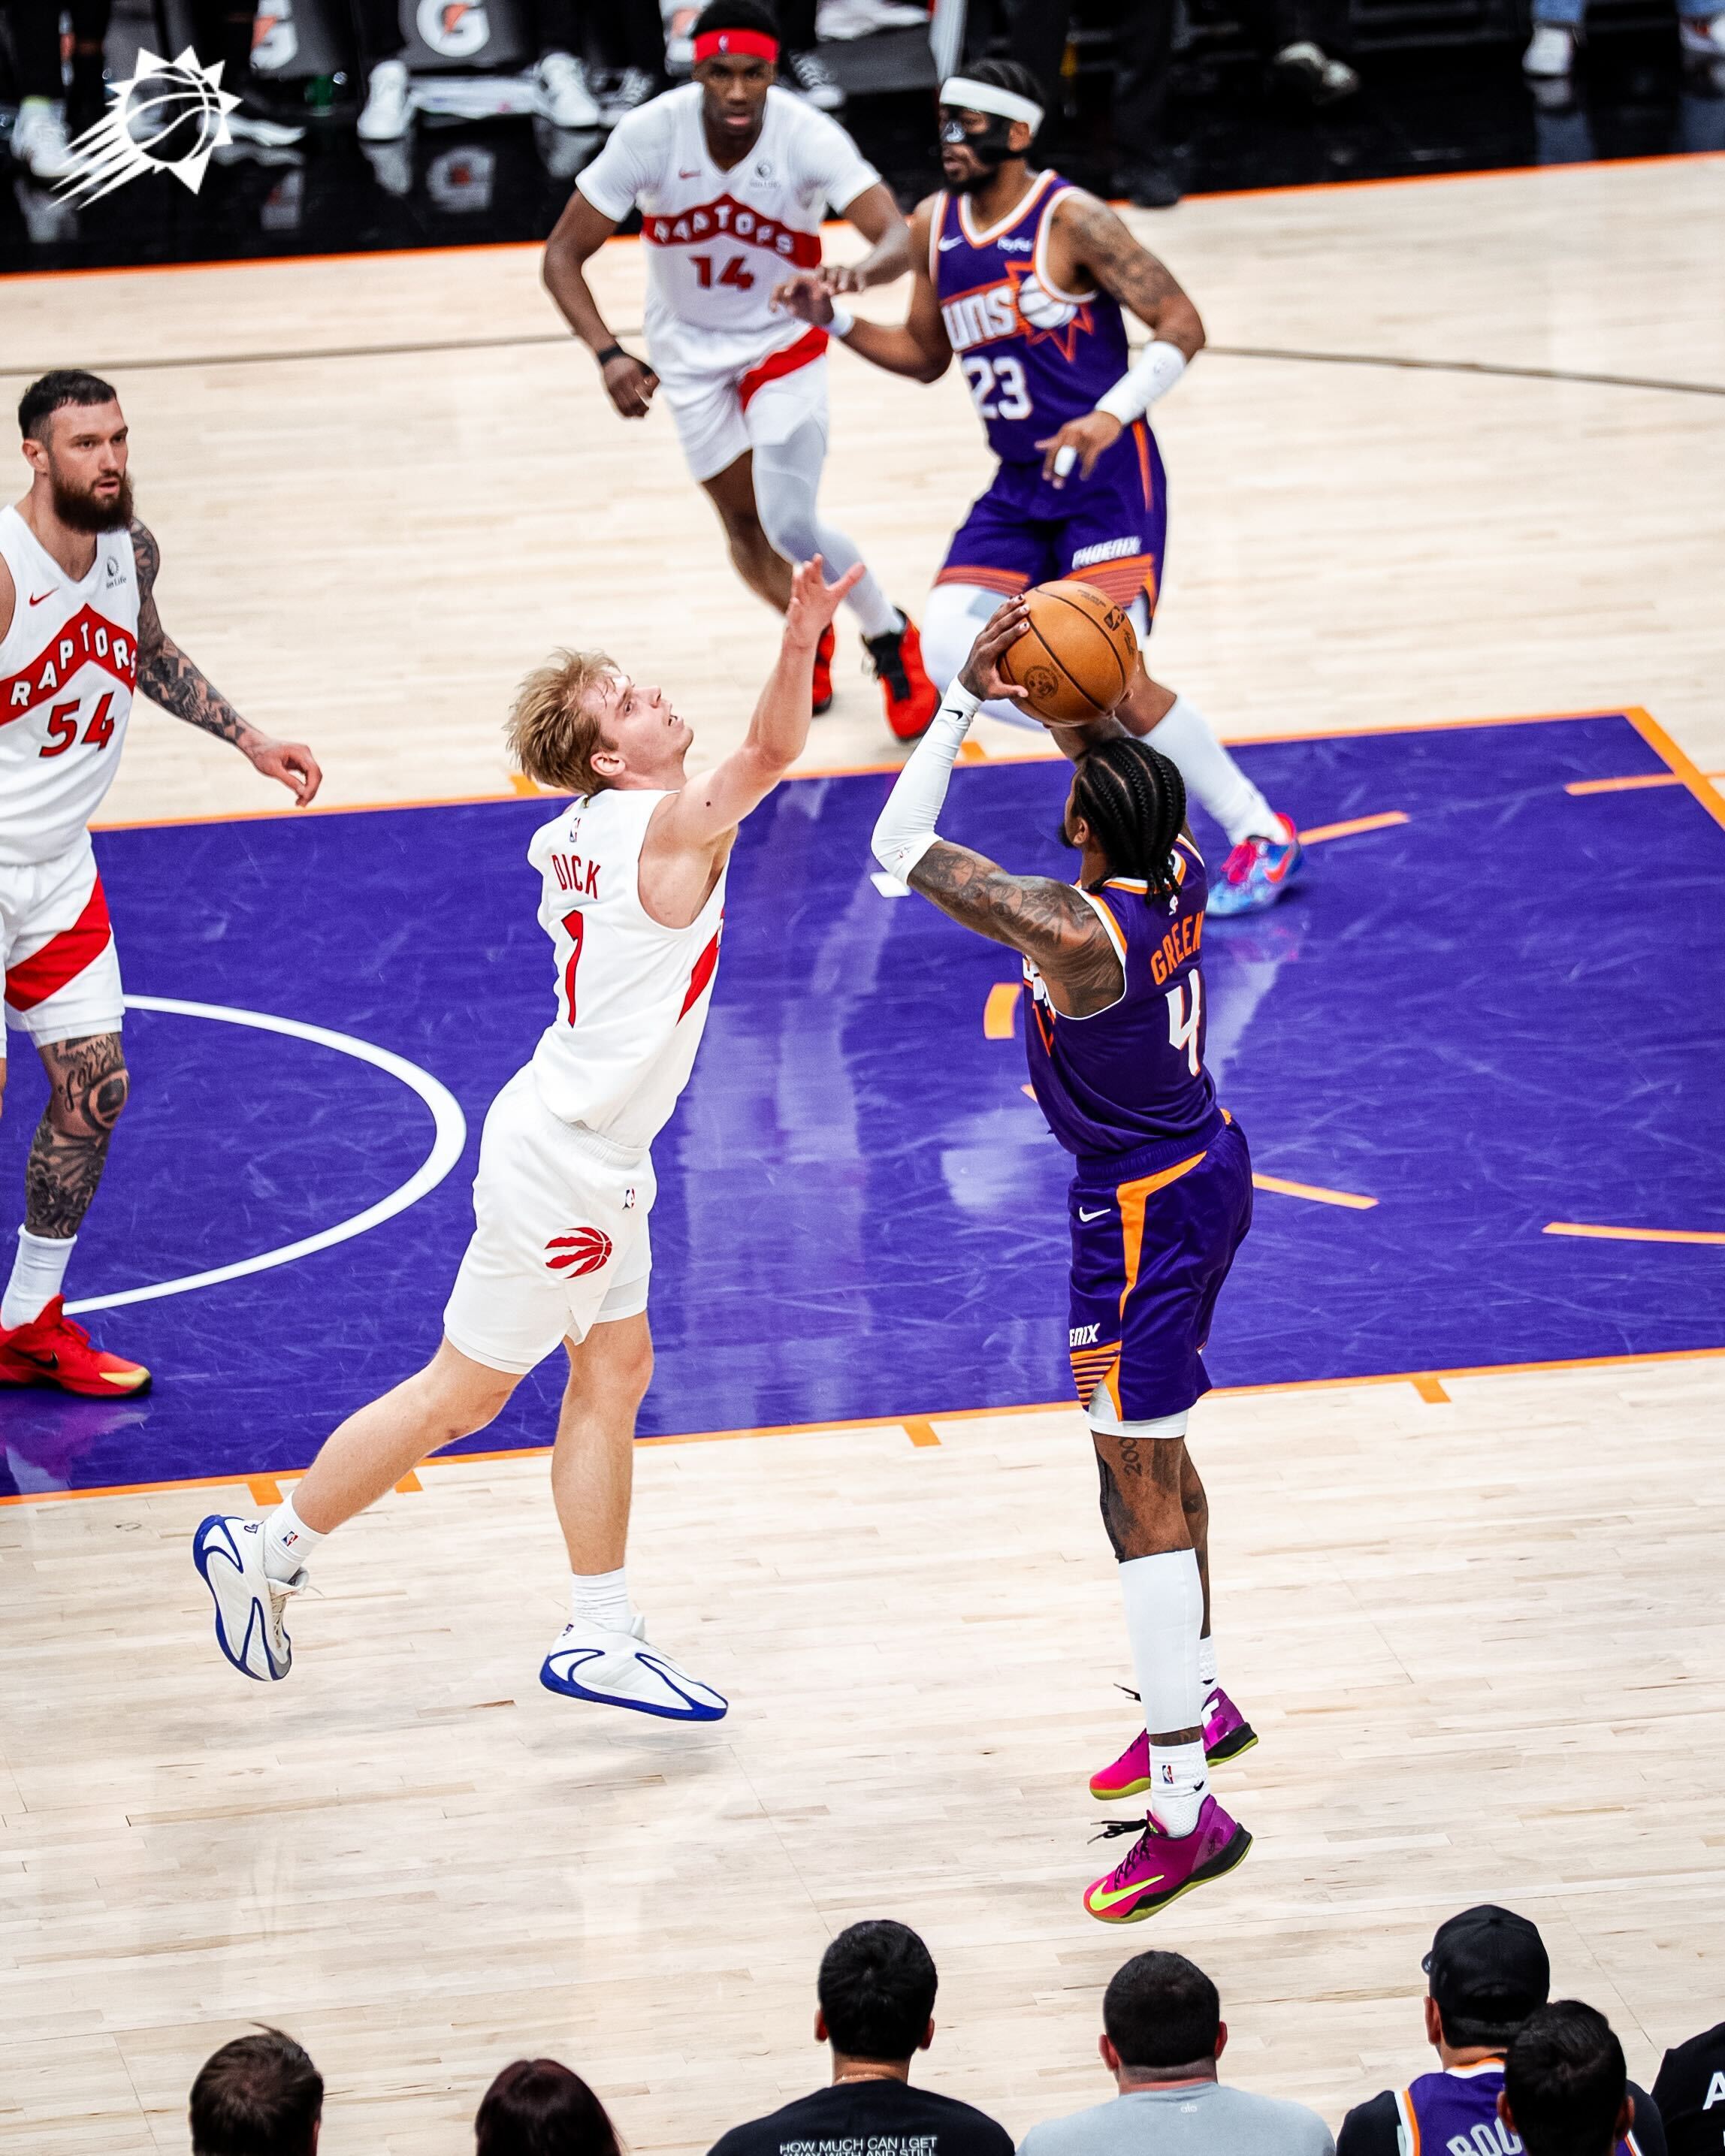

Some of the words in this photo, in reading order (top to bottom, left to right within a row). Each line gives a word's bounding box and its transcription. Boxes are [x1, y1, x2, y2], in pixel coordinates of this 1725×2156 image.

[654, 204, 795, 254] RAPTORS
[689, 255, 754, 291] 14
[941, 285, 1017, 352] UNS
[961, 356, 1033, 421] 23
[10, 621, 137, 707] RAPTORS
[38, 691, 115, 758] 54
[551, 853, 601, 900] DICK
[561, 910, 584, 1028] 1
[1150, 909, 1205, 986] GREEN
[1165, 968, 1201, 1077] 4
[1069, 1322, 1101, 1348] ENIX
[779, 2140, 815, 2154] HOW
[819, 2139, 863, 2152] MUCH
[867, 2136, 898, 2150] CAN
[902, 2137, 905, 2149] I
[908, 2136, 938, 2148] GET
